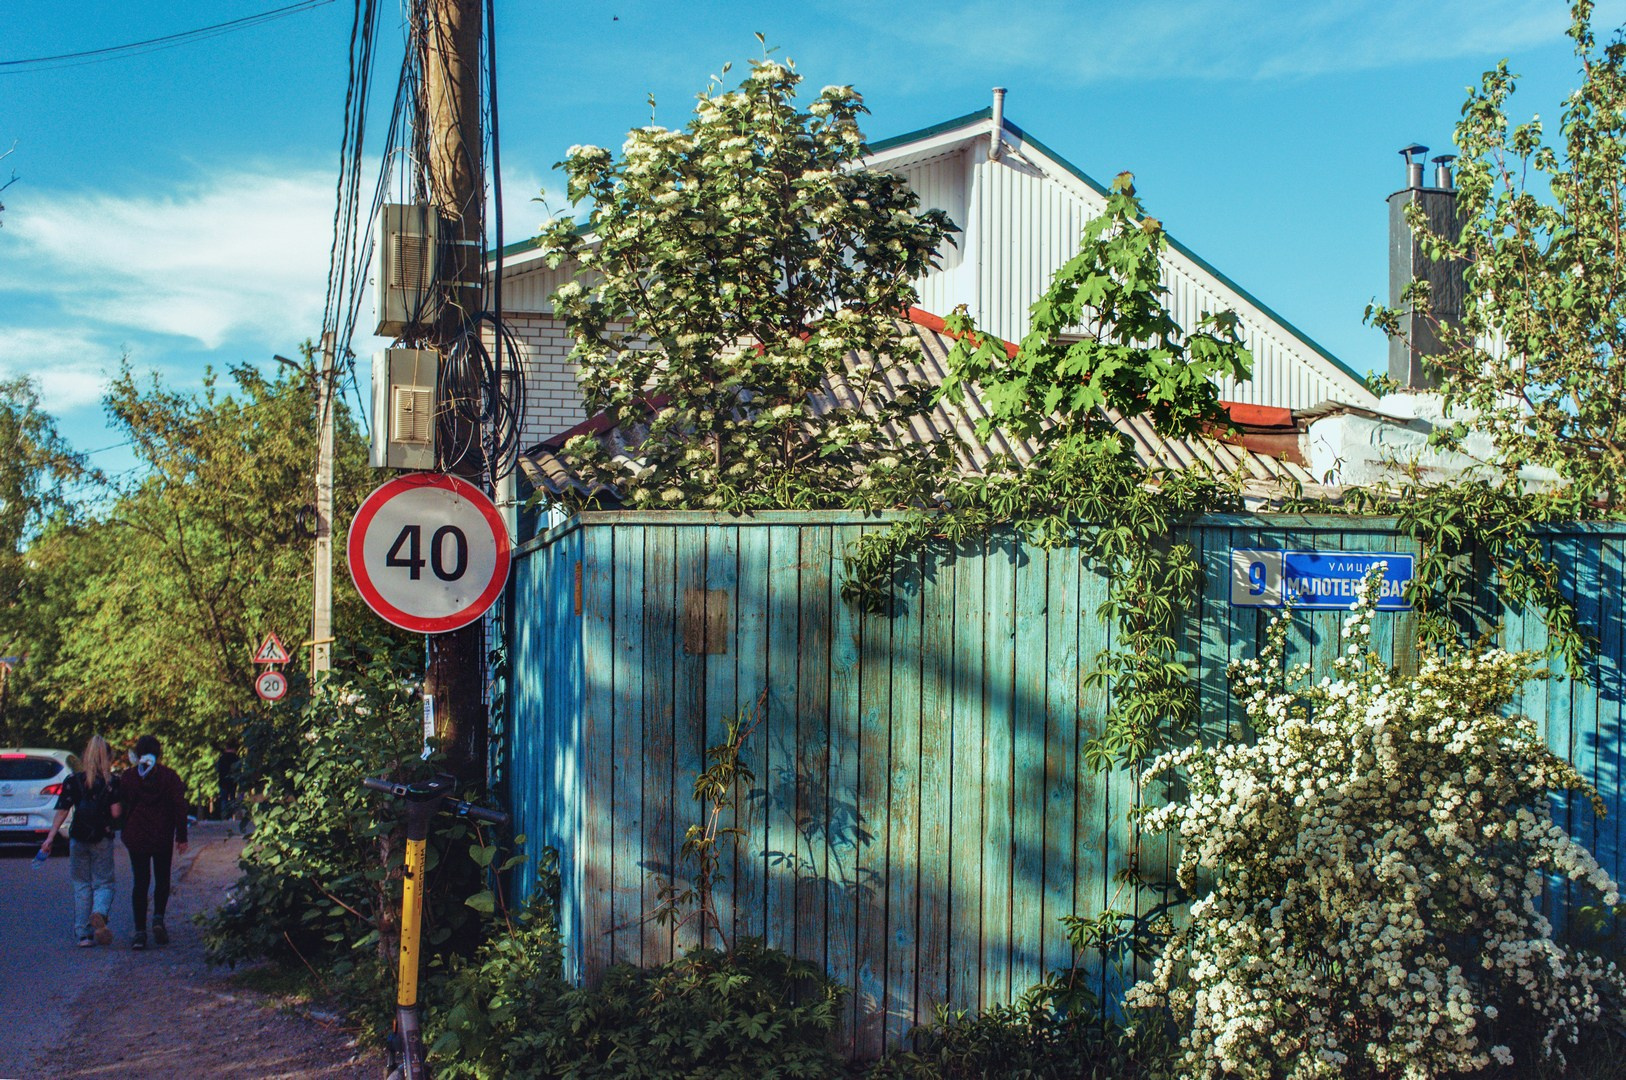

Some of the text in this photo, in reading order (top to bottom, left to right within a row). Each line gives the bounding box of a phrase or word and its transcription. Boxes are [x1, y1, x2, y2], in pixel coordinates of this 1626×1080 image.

[386, 525, 468, 581] 40
[1329, 562, 1371, 573] УЛИЦА
[1249, 561, 1266, 596] 9
[1287, 577, 1410, 597] МАЛОТЕРВАЯ
[264, 681, 279, 691] 20
